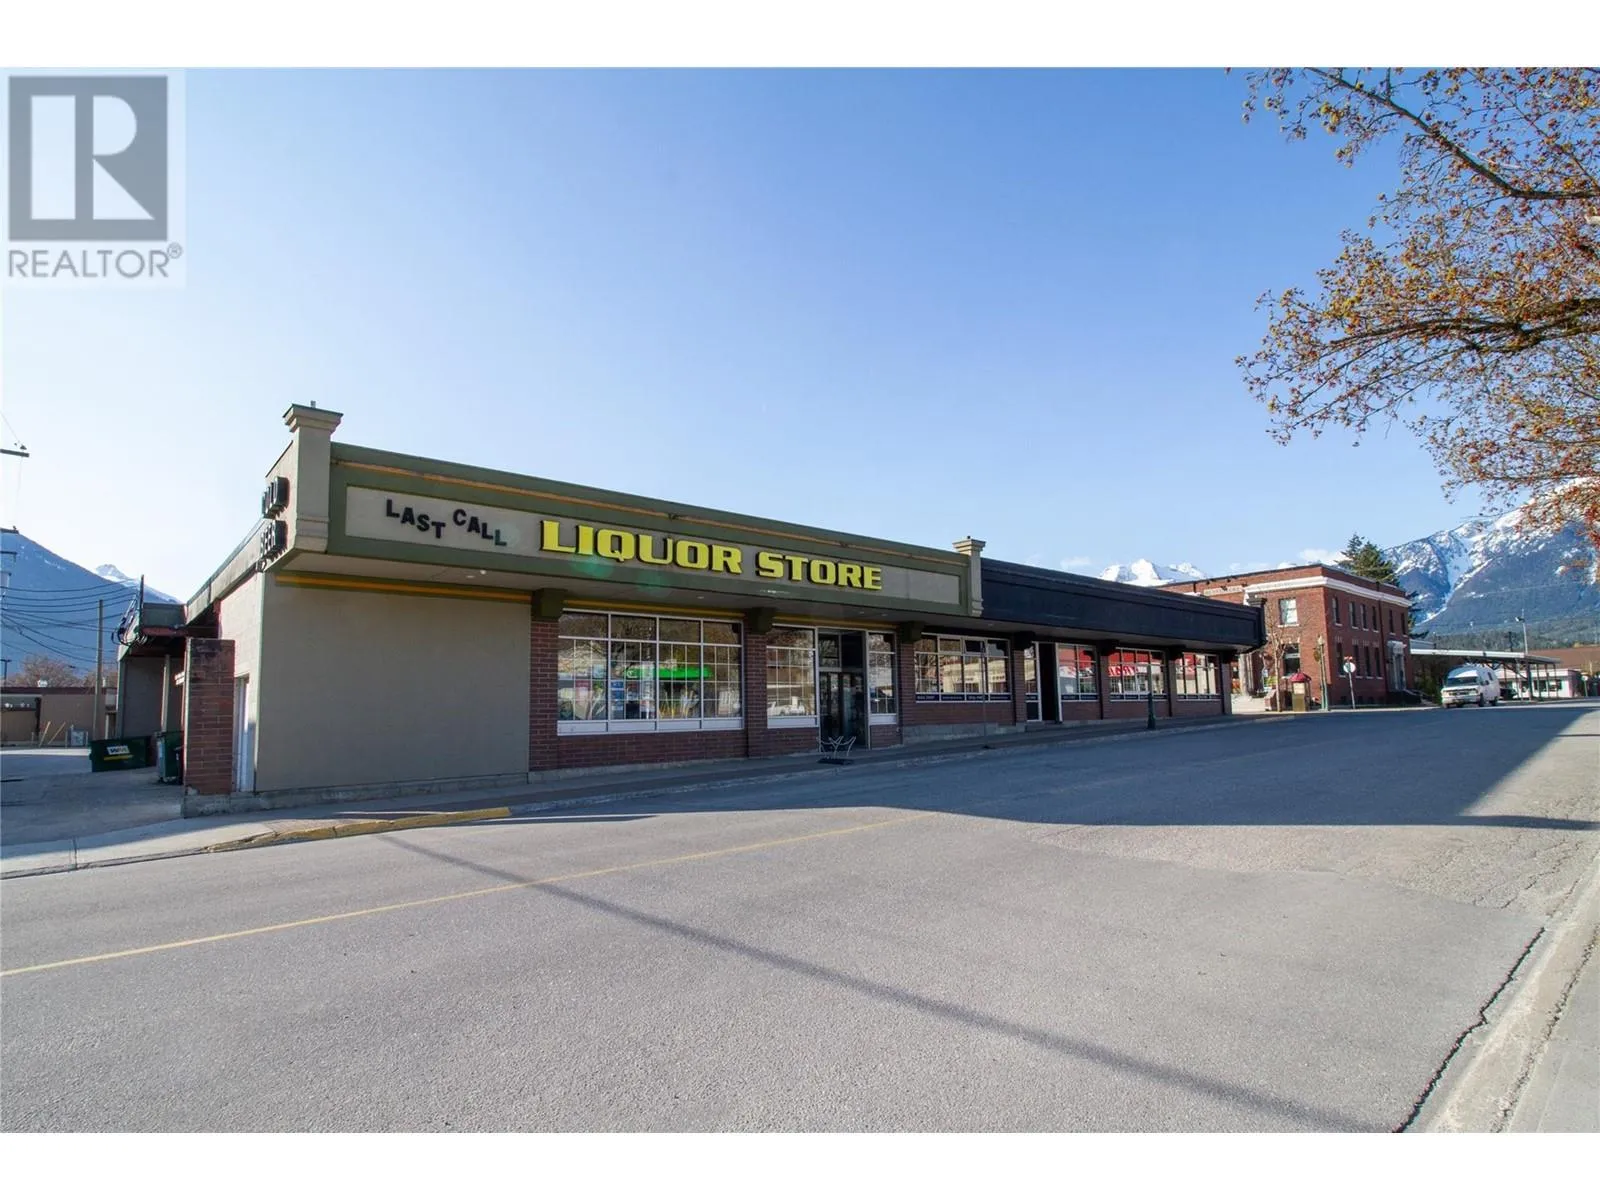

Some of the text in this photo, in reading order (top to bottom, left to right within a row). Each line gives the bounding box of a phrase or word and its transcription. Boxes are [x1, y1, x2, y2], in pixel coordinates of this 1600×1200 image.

[386, 498, 508, 547] LAST CALL
[540, 520, 883, 591] LIQUOR STORE
